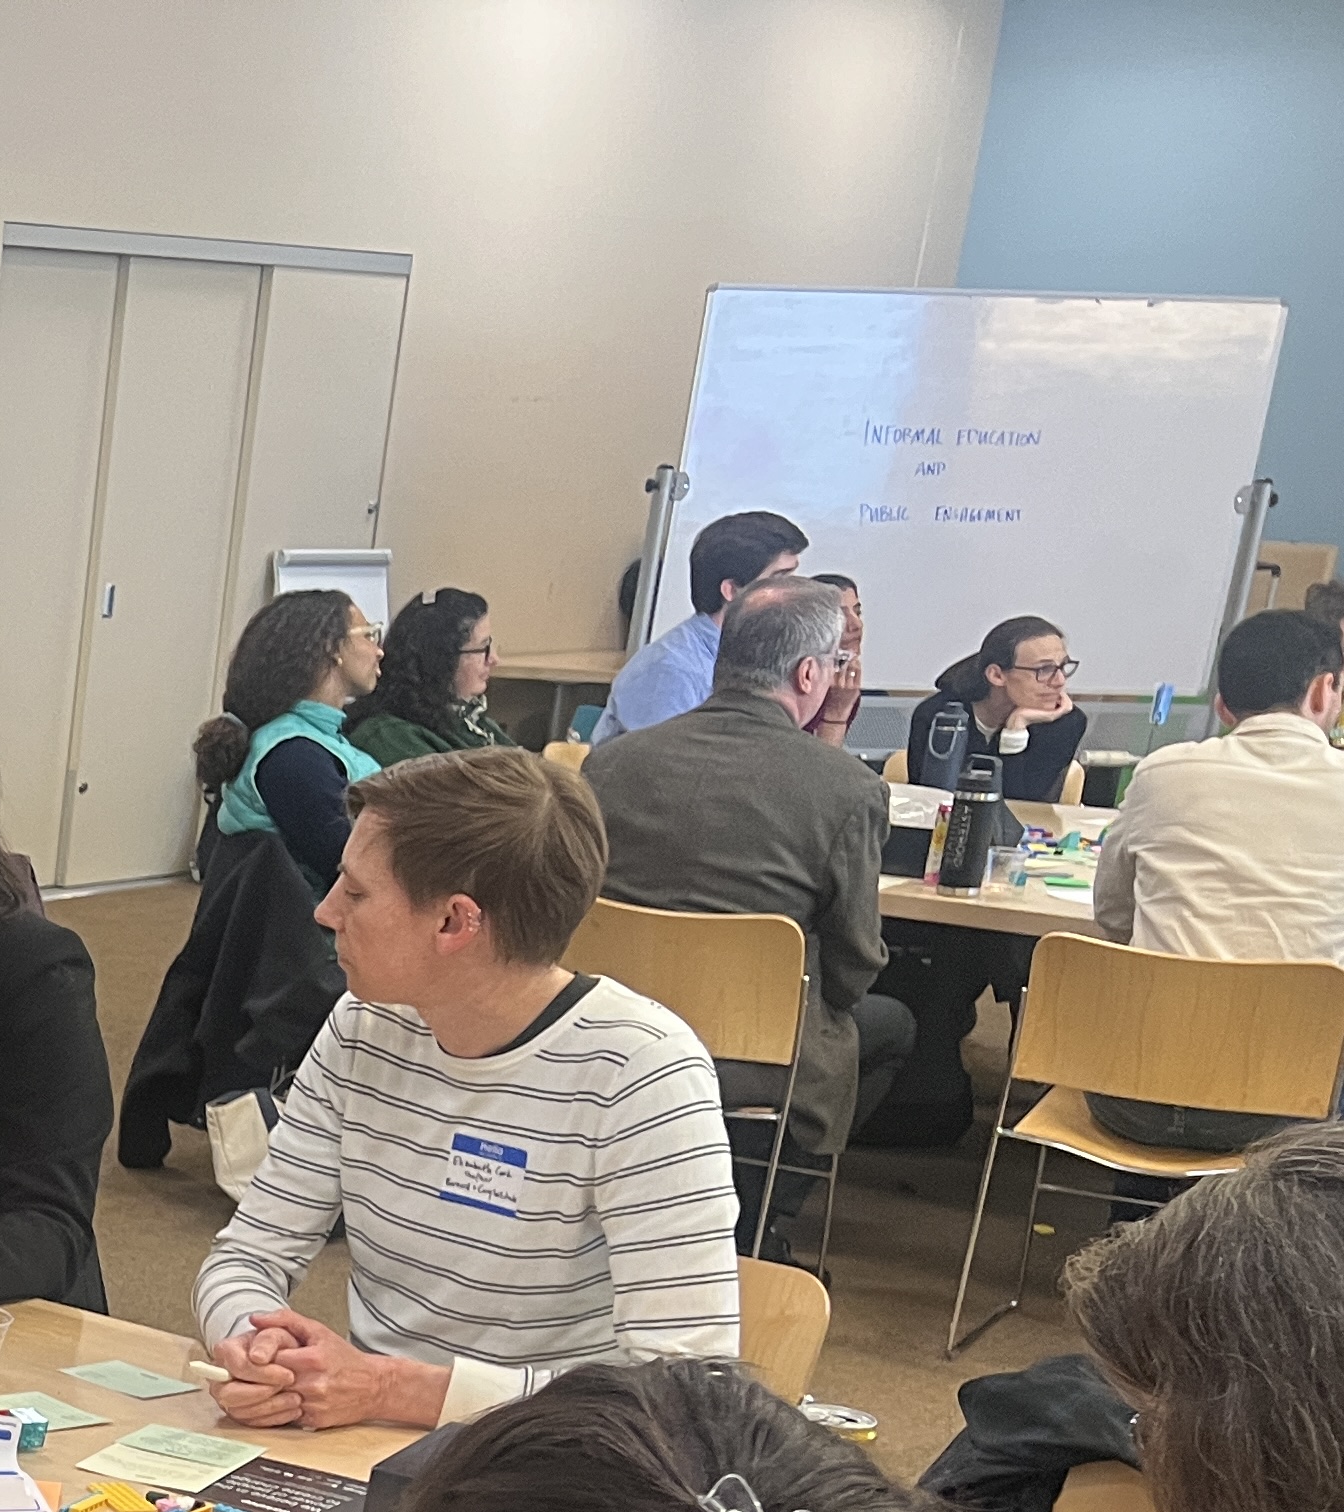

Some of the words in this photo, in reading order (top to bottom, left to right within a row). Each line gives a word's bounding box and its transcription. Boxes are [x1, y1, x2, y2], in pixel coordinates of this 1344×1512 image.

[863, 418, 943, 447] INFORMAL
[955, 428, 1043, 447] EDUCATION
[858, 502, 910, 524] PUBLIC
